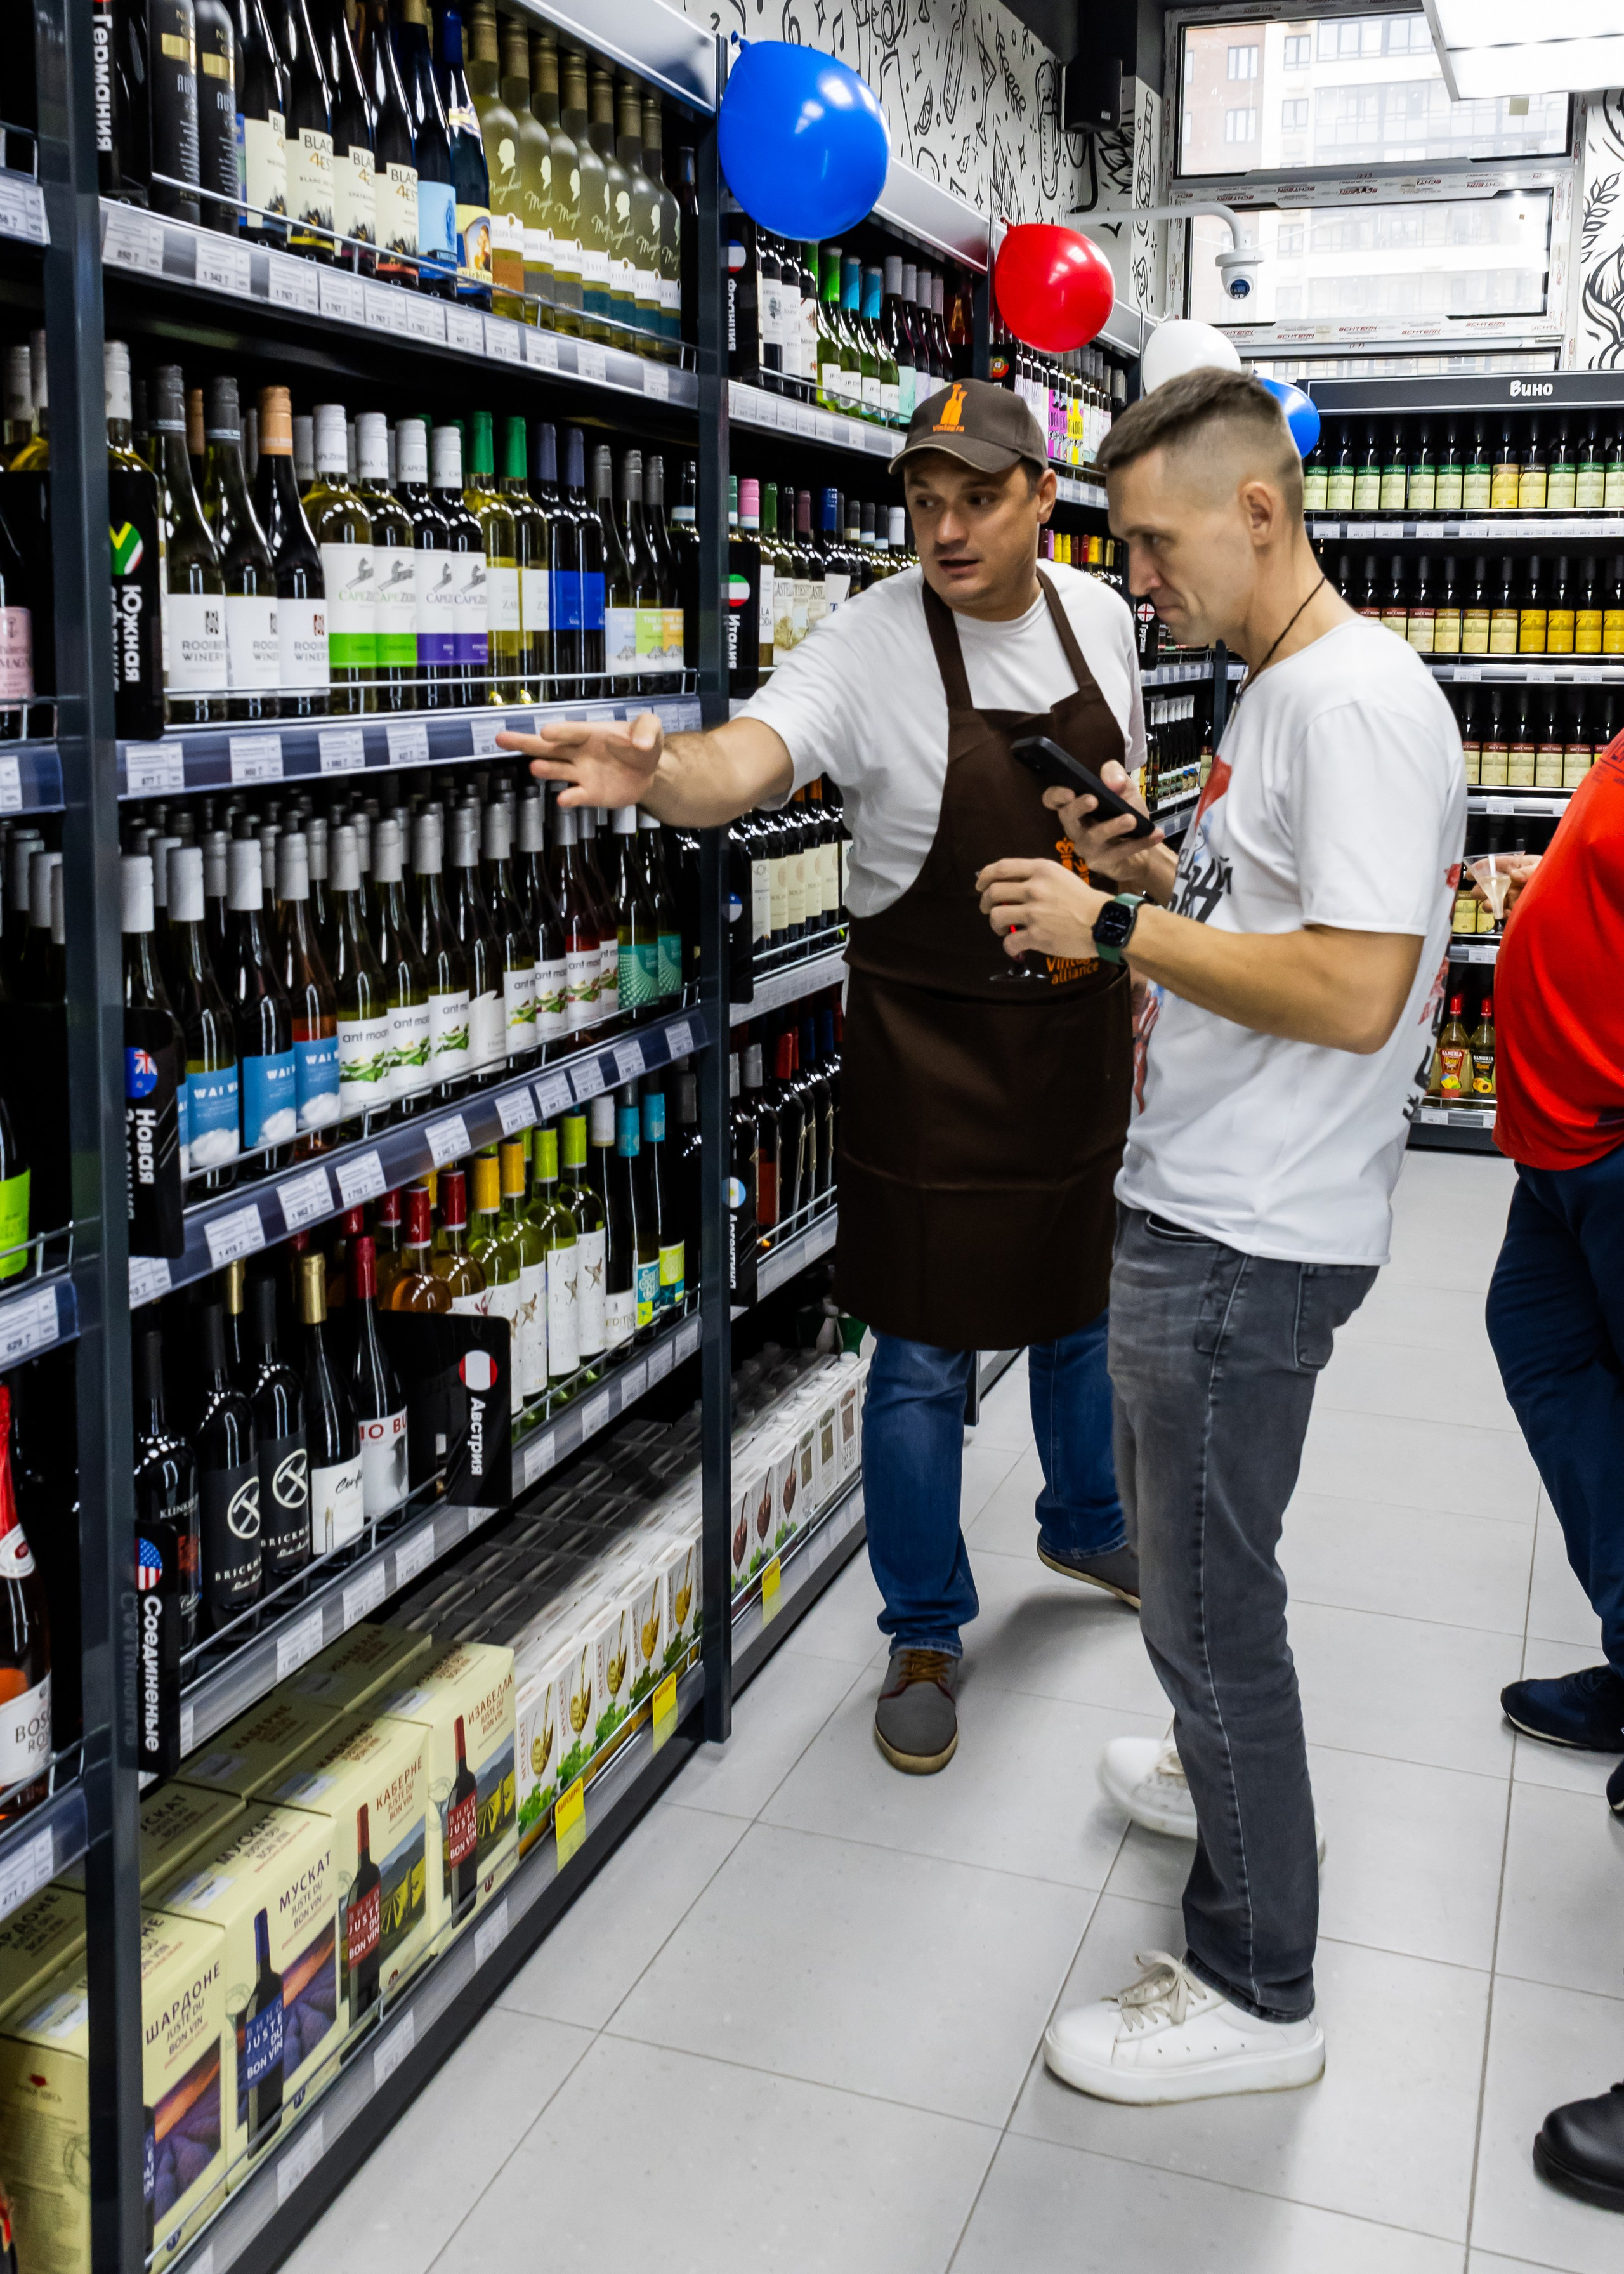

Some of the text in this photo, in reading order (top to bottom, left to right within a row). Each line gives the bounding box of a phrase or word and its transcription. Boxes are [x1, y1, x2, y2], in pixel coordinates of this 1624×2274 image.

[93, 14, 113, 152] Германия
[1510, 379, 1553, 397] Вино
[122, 584, 143, 683] Южная
[729, 614, 740, 670] Италия
[1051, 961, 1099, 985] alliance
[343, 1031, 363, 1043] ant
[306, 1052, 331, 1065] WAI
[193, 1085, 223, 1100] WAI
[135, 1108, 157, 1185] Новая
[470, 1397, 486, 1476] Австрия
[143, 1595, 163, 1753] Соединеные
[468, 1673, 513, 1726] ИЗАБЕЛЛА
[376, 1754, 422, 1812] КАБЕРНЕ
[557, 1782, 582, 1814] ВЫГОДНО
[449, 1806, 476, 1839] JUSTE
[467, 1817, 476, 1834] DU
[450, 1828, 476, 1860] BON VIN
[279, 1849, 331, 1914] МУСКАТ
[291, 1879, 324, 1917] JUSTE DU
[293, 1909, 310, 1929] BON
[349, 1900, 380, 1936] JUSTE
[369, 1912, 380, 1931] DU
[349, 1924, 380, 1961] BON VIN
[146, 1960, 221, 2046] ШАРДОНЕ
[167, 1998, 205, 2044] JUSTE DU
[169, 2014, 204, 2056] BON VIN
[246, 2011, 284, 2055] JUSTE
[270, 2024, 283, 2046] DU
[247, 2036, 284, 2080] BON VIN
